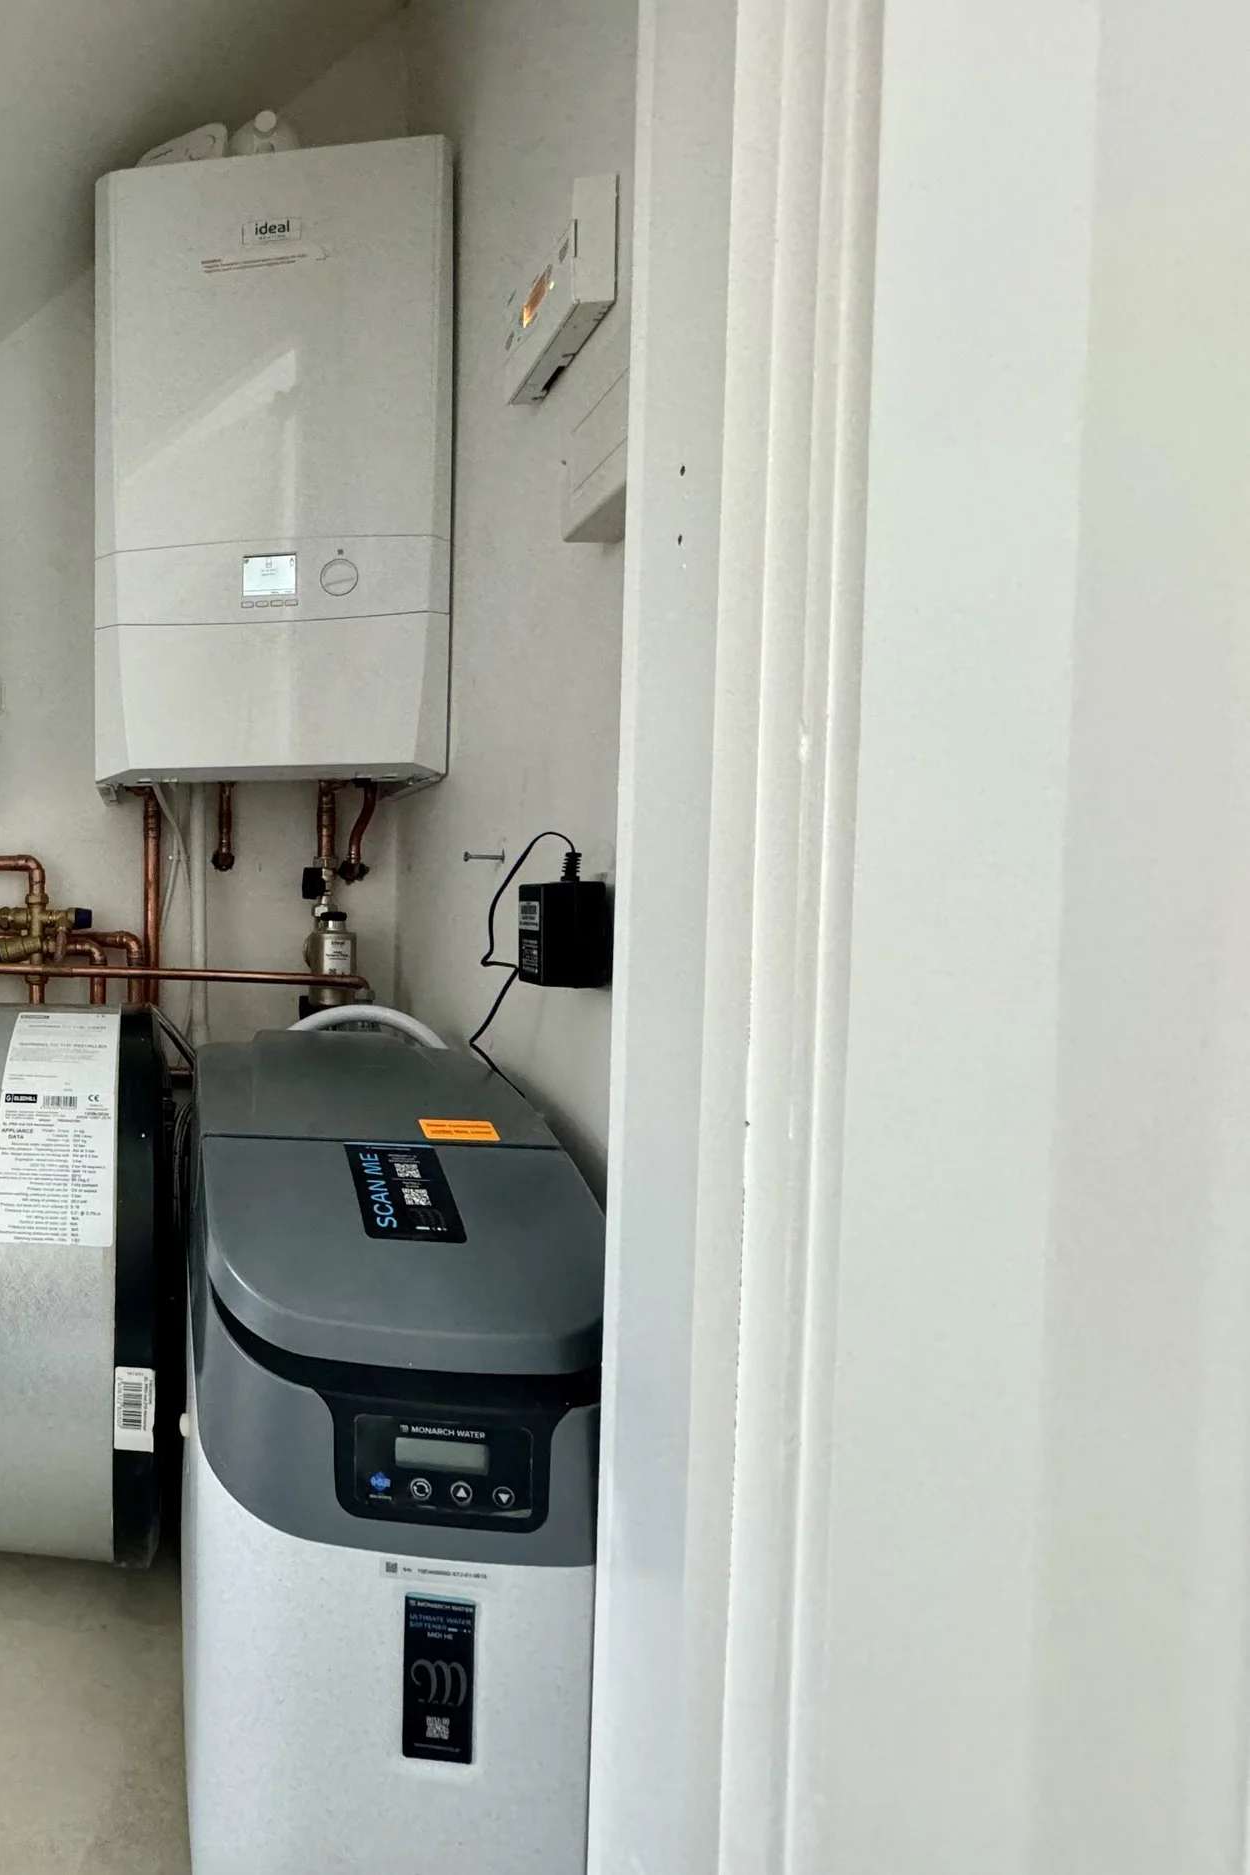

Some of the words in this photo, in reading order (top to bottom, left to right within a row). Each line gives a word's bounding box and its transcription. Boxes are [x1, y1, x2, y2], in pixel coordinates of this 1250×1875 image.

[255, 220, 290, 235] ideal
[360, 1153, 383, 1175] ME
[367, 1180, 397, 1228] SCAN
[411, 1425, 455, 1437] MONARCH
[456, 1430, 486, 1440] WATER
[409, 1613, 444, 1623] ULTIMATE
[446, 1616, 471, 1626] WATER
[409, 1621, 447, 1631] SOFTENER
[427, 1631, 443, 1639] MIDI
